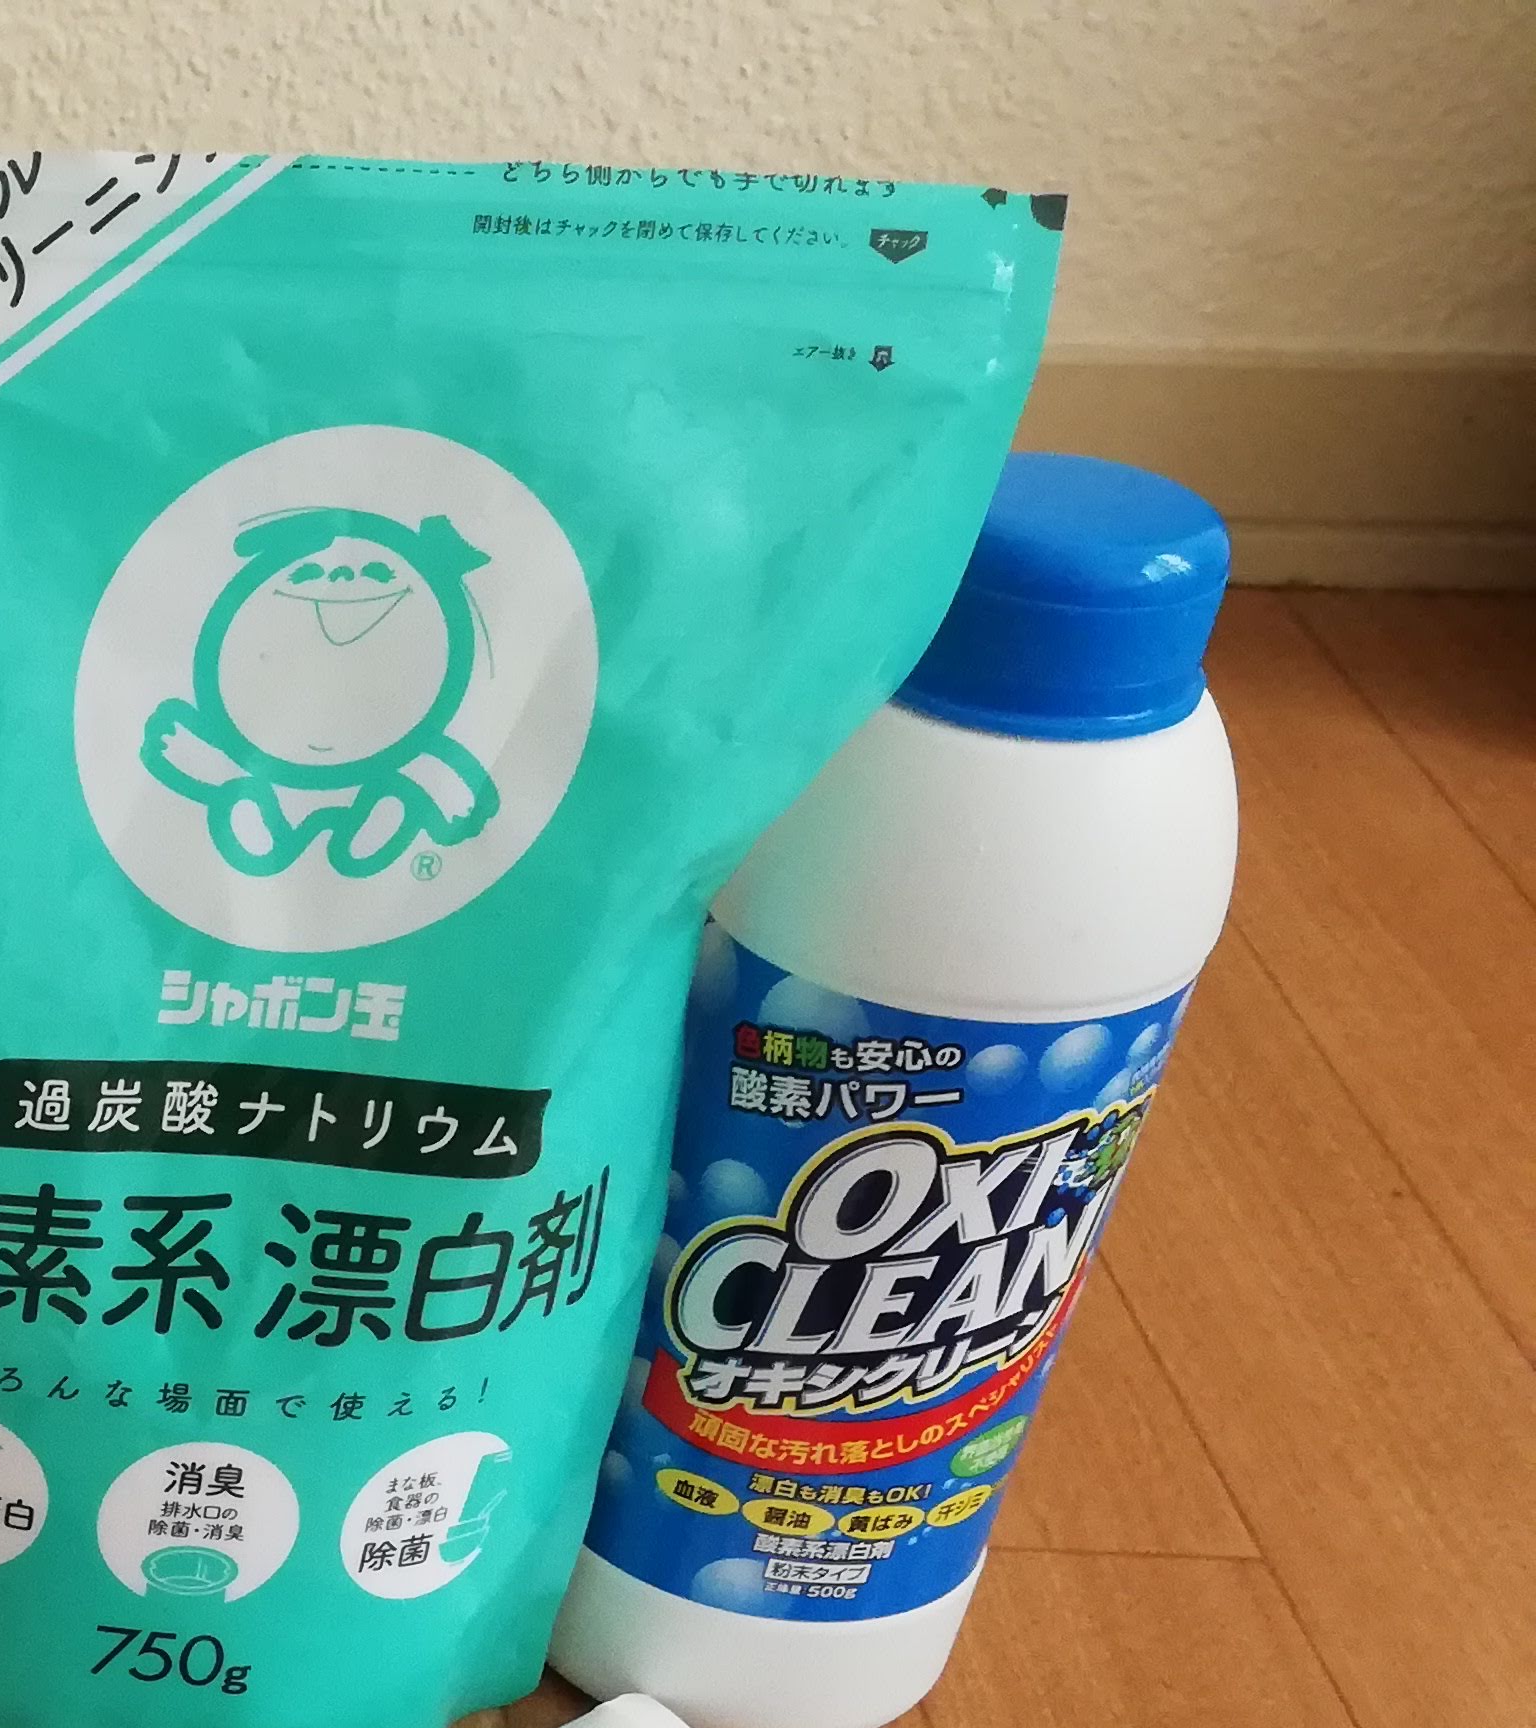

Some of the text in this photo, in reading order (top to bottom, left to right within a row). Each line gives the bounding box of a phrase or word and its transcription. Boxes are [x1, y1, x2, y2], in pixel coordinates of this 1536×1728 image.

[158, 969, 408, 1042] シャボン玉
[734, 1022, 962, 1073] 色柄物も安心の
[14, 1078, 522, 1158] 過炭酸ナトリウム
[731, 1067, 961, 1121] 酸素パワー
[799, 1123, 1081, 1260] OXI
[253, 1164, 612, 1348] 漂白剤
[676, 1177, 1117, 1355] CLEAN
[691, 1297, 1062, 1406] オキシクリーン
[163, 1460, 245, 1498] 消臭
[751, 1472, 933, 1506] 漂白も消臭もOK!
[148, 1520, 245, 1542] 除菌・消臭
[365, 1506, 448, 1532] 除菌・漂白
[160, 1501, 238, 1520] 排水口の
[385, 1492, 440, 1512] 食器の
[674, 1479, 719, 1509] 血液
[847, 1513, 914, 1534] 黄ばみ
[936, 1489, 987, 1522] 汗ジミ
[358, 1534, 434, 1573] 除菌
[753, 1534, 894, 1561] 酸素系漂白剤
[769, 1560, 870, 1583] 粉末タイプ
[807, 1583, 858, 1600] 500g
[90, 1624, 252, 1694] 750g
